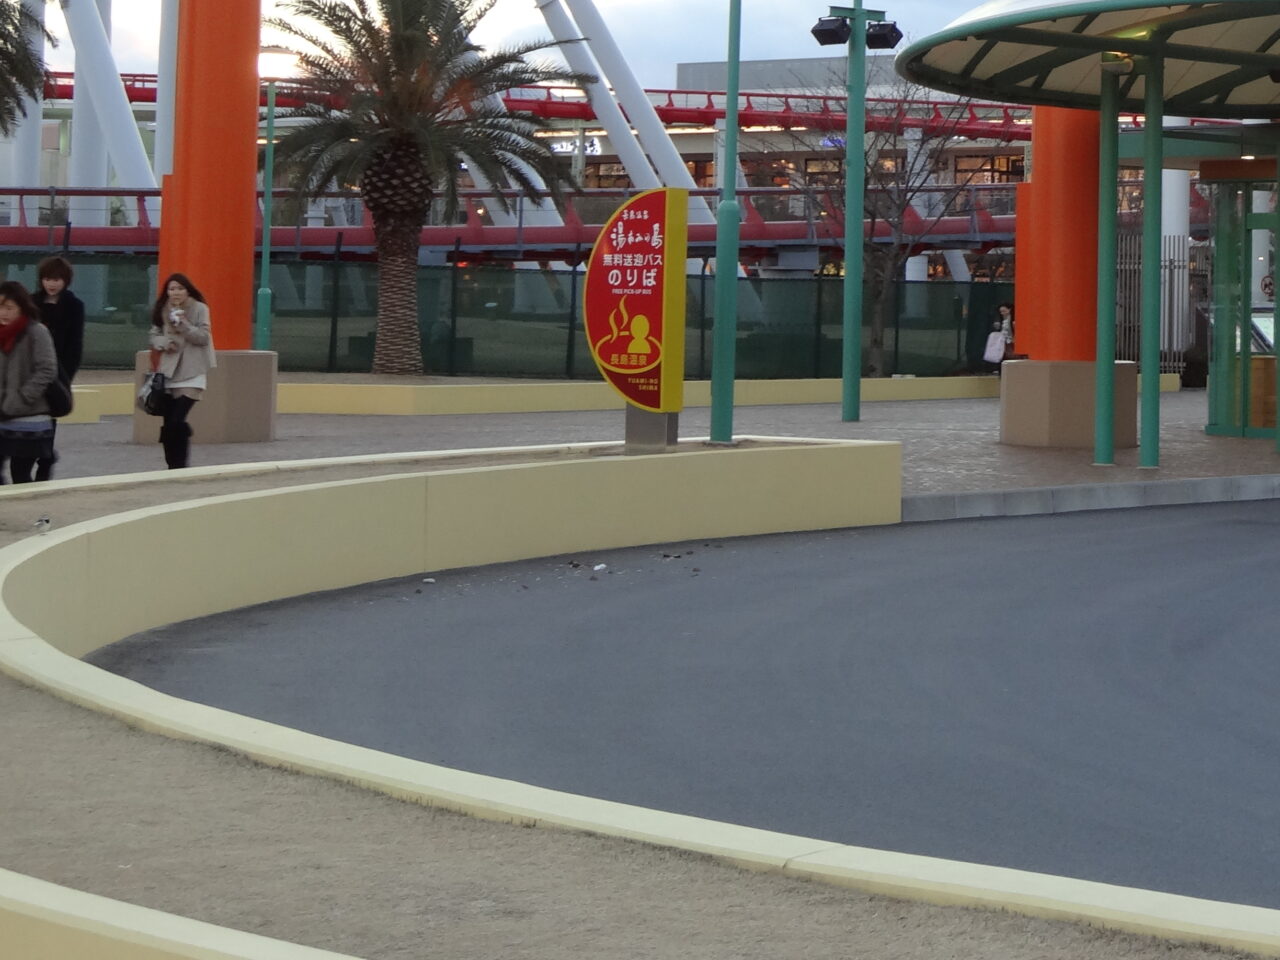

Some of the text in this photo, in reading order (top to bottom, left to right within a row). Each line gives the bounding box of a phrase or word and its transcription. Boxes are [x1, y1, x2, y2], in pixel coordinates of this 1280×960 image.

[603, 253, 662, 266] 無料送迎バス
[608, 268, 657, 286] のりば
[610, 353, 647, 365] 長島温泉
